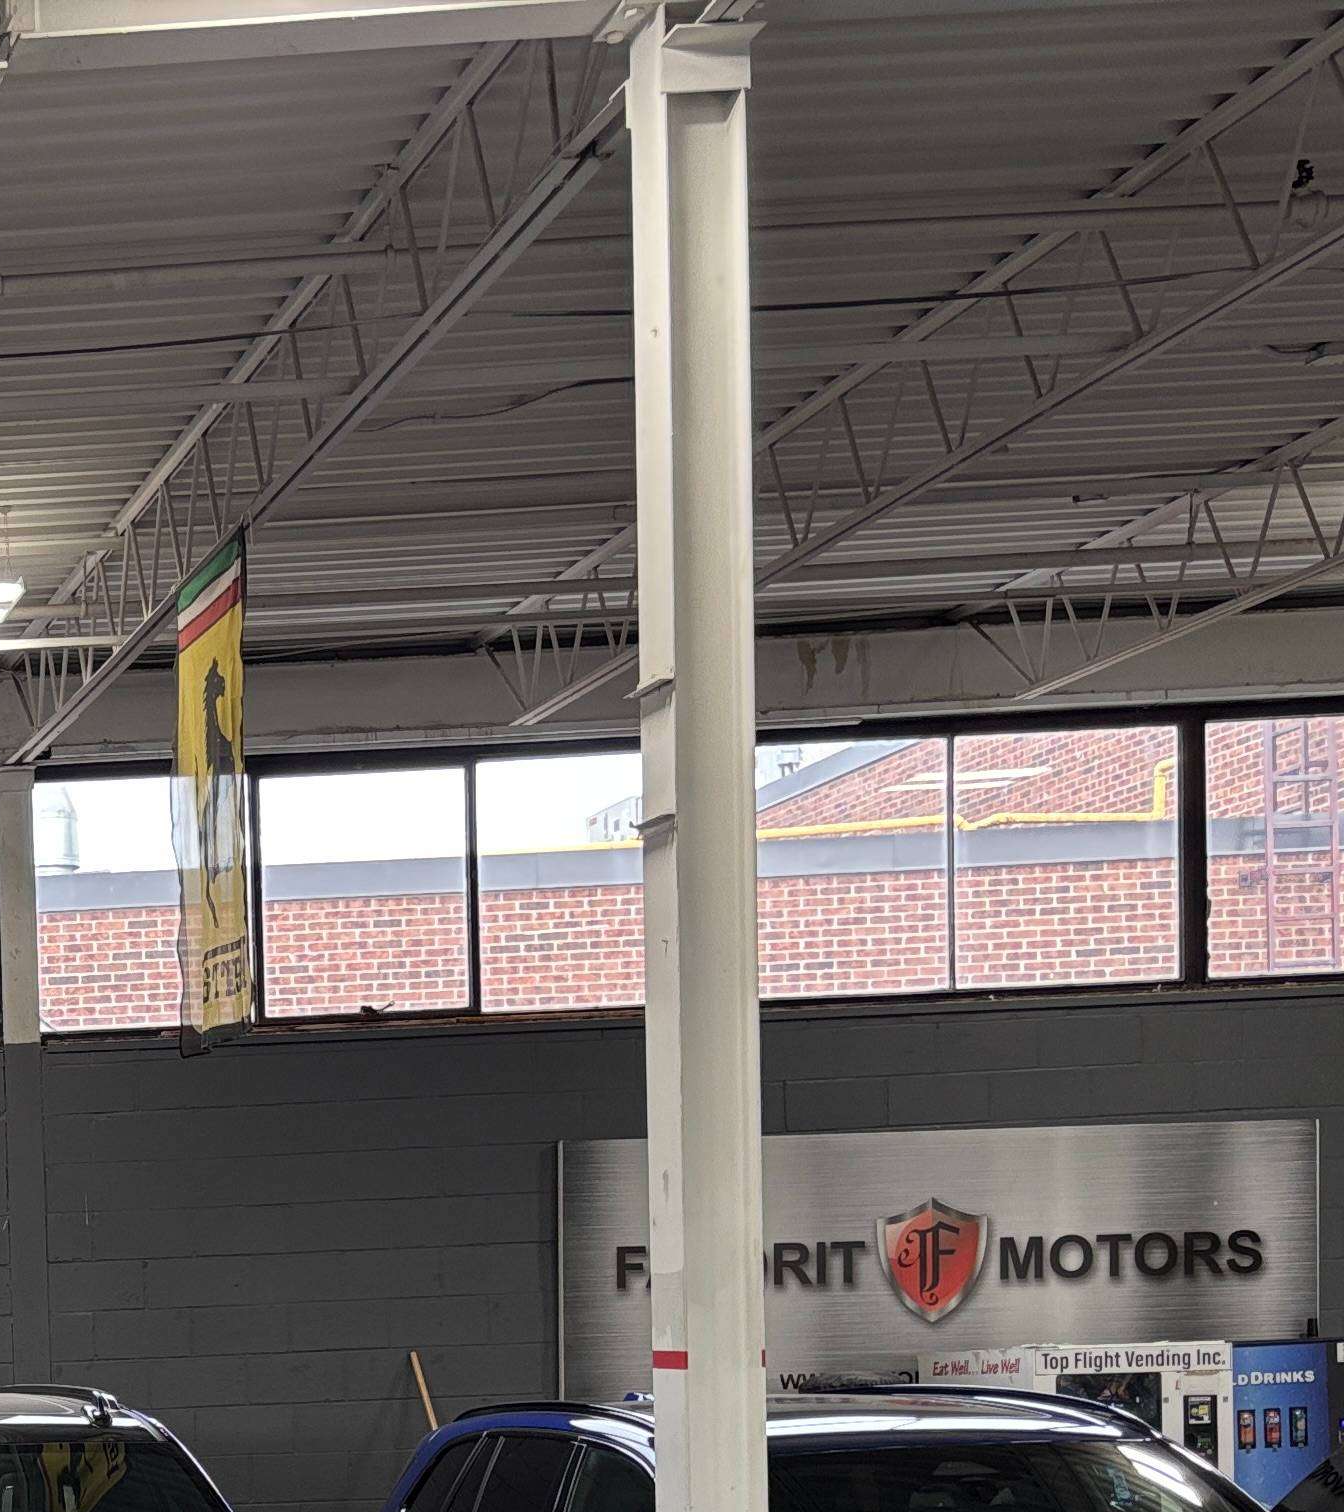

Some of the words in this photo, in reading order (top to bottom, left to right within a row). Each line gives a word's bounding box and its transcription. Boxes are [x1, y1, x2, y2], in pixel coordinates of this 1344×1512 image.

[616, 1240, 866, 1290] FRIT
[1000, 1229, 1263, 1282] MOTORS
[932, 1361, 949, 1377] Eat
[981, 1359, 1000, 1375] Live
[1041, 1352, 1070, 1373] Top
[1074, 1351, 1122, 1373] Flight
[1124, 1349, 1192, 1371] Vending
[1196, 1349, 1226, 1366] Inc.
